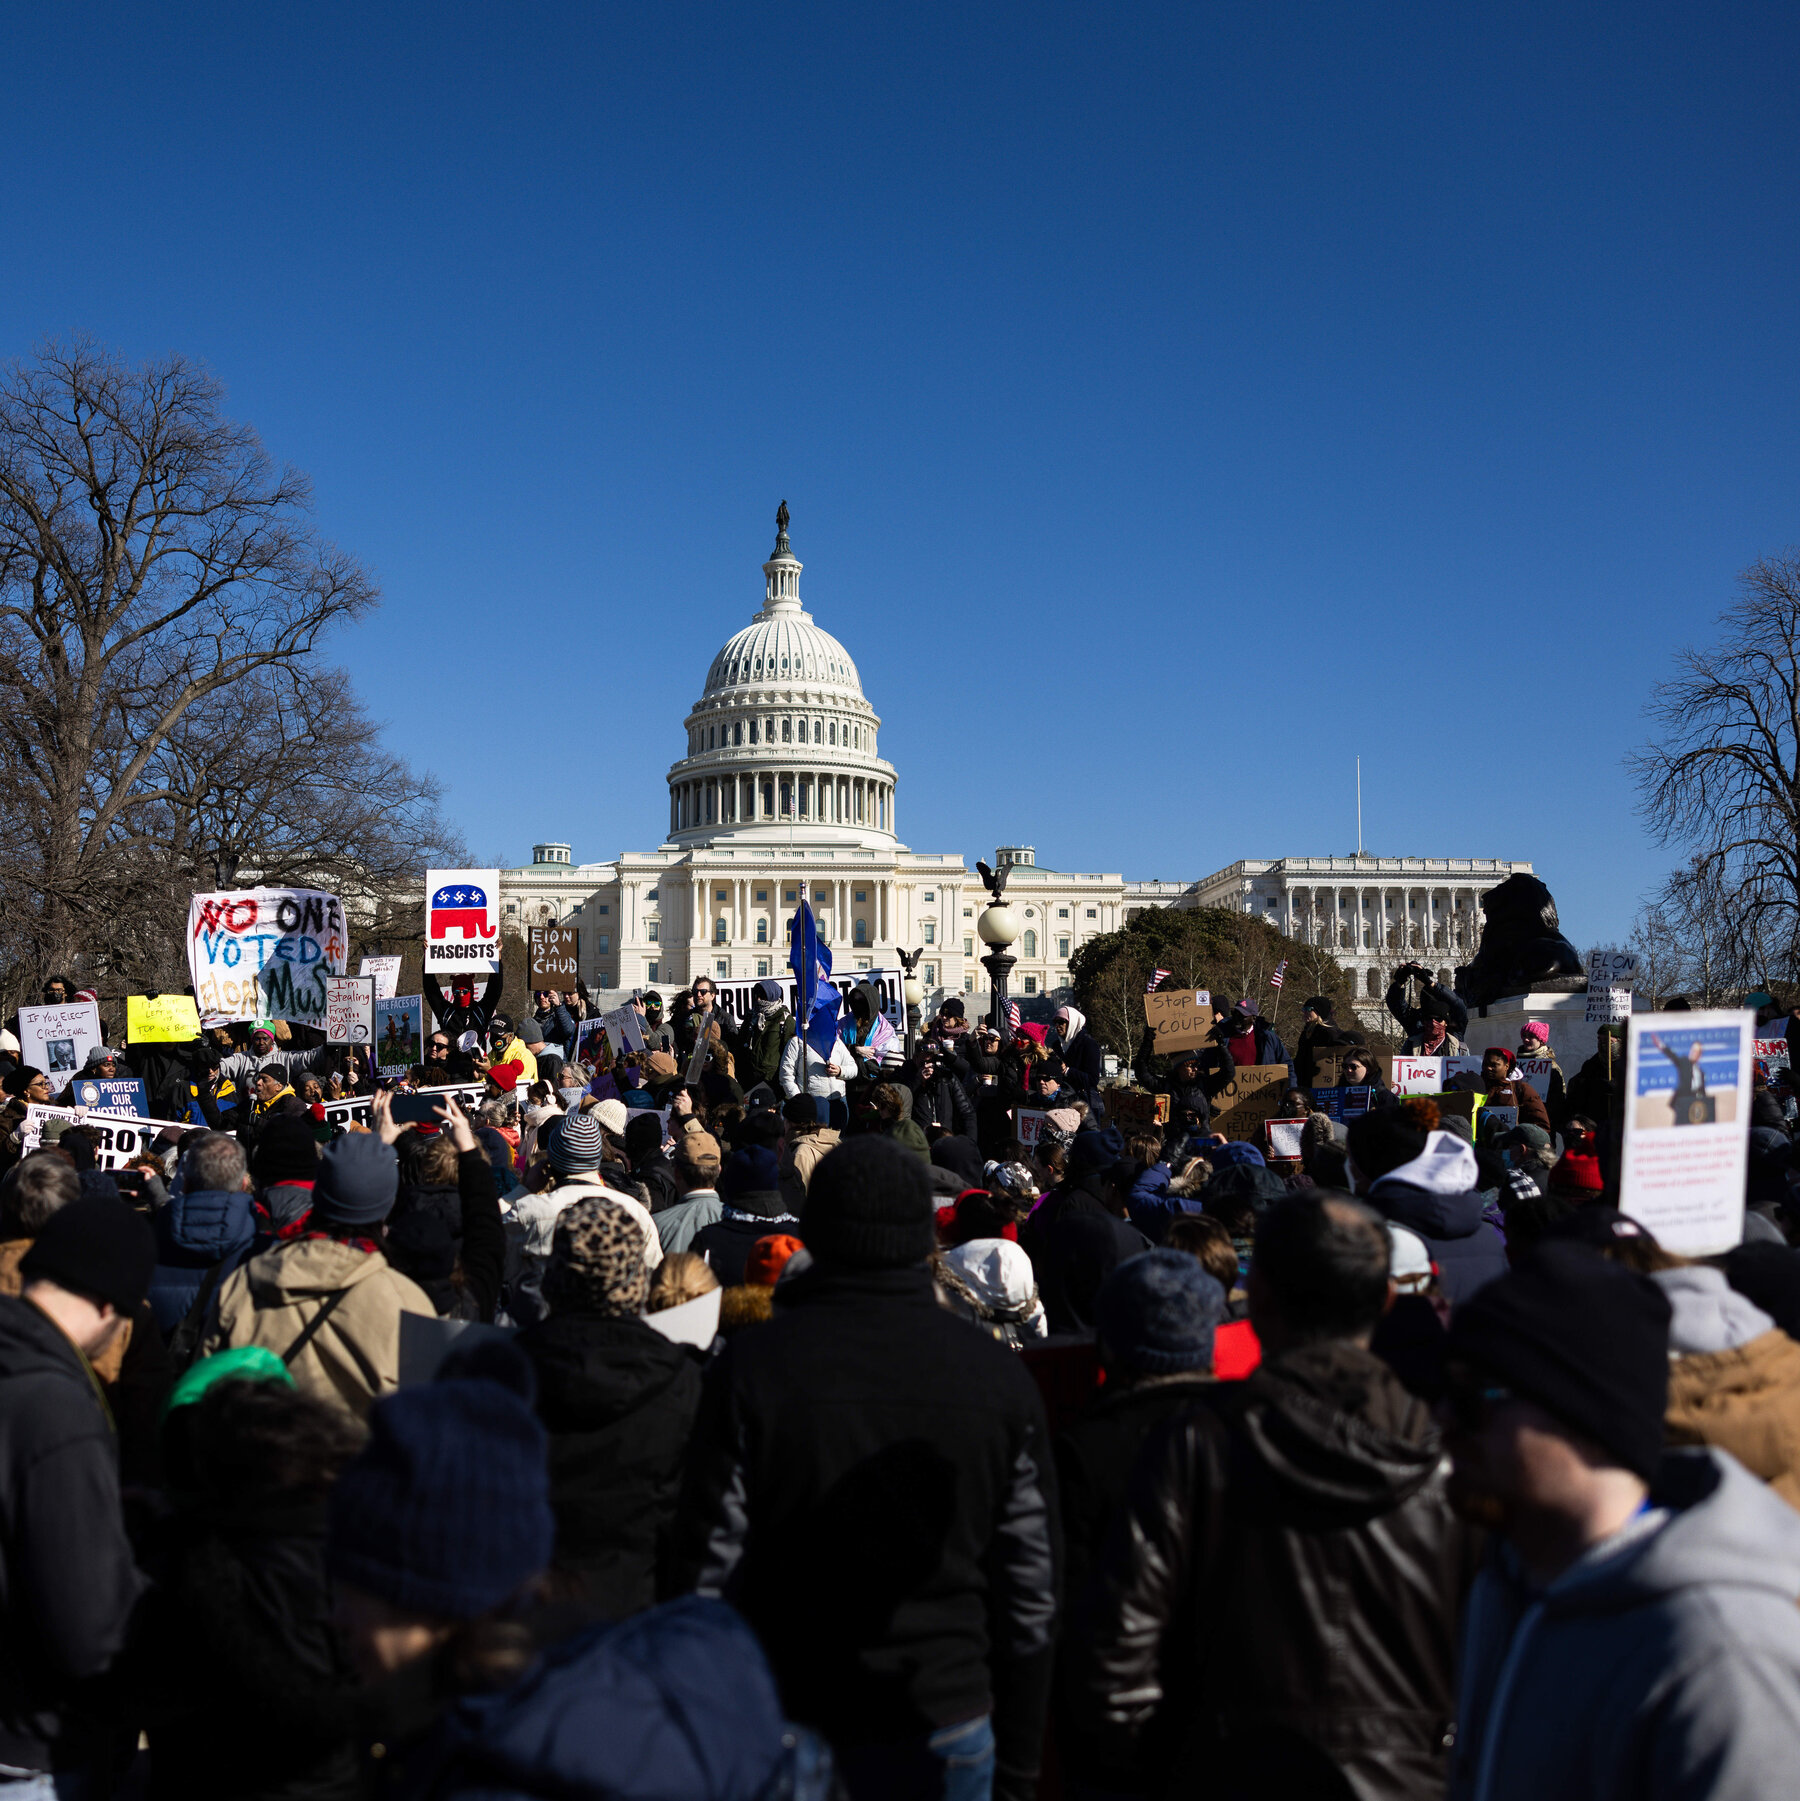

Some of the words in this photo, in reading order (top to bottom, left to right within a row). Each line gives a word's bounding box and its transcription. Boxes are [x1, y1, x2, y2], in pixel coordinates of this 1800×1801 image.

[194, 899, 258, 939] NO
[277, 897, 341, 934] ONE
[203, 929, 322, 970] VOTED
[429, 943, 495, 959] FASCISTS
[533, 943, 546, 956] IS
[549, 945, 560, 955] A
[532, 957, 578, 974] CHUD
[1591, 953, 1635, 970] ELON
[332, 979, 359, 990] I'm
[327, 990, 370, 1005] Stealing
[328, 1004, 353, 1015] From
[377, 1000, 390, 1010] THE
[391, 998, 410, 1009] FACES
[411, 998, 420, 1007] OF
[27, 1013, 40, 1023] IF
[42, 1012, 58, 1023] YOU
[60, 1011, 90, 1021] ELECT
[56, 1021, 62, 1029] A
[136, 1025, 155, 1035] TOP
[580, 1020, 593, 1031] THE
[1157, 1016, 1205, 1034] COUP
[36, 1028, 88, 1039] CRIMINAL
[378, 1064, 408, 1076] FOREIGN
[1392, 1058, 1436, 1083] Time
[1241, 1072, 1274, 1085] KING
[100, 1081, 139, 1094] PROTECT
[111, 1094, 132, 1105] OUR
[35, 1110, 47, 1119] WE
[1232, 1111, 1267, 1121] STOP
[1226, 1121, 1258, 1136] FELO
